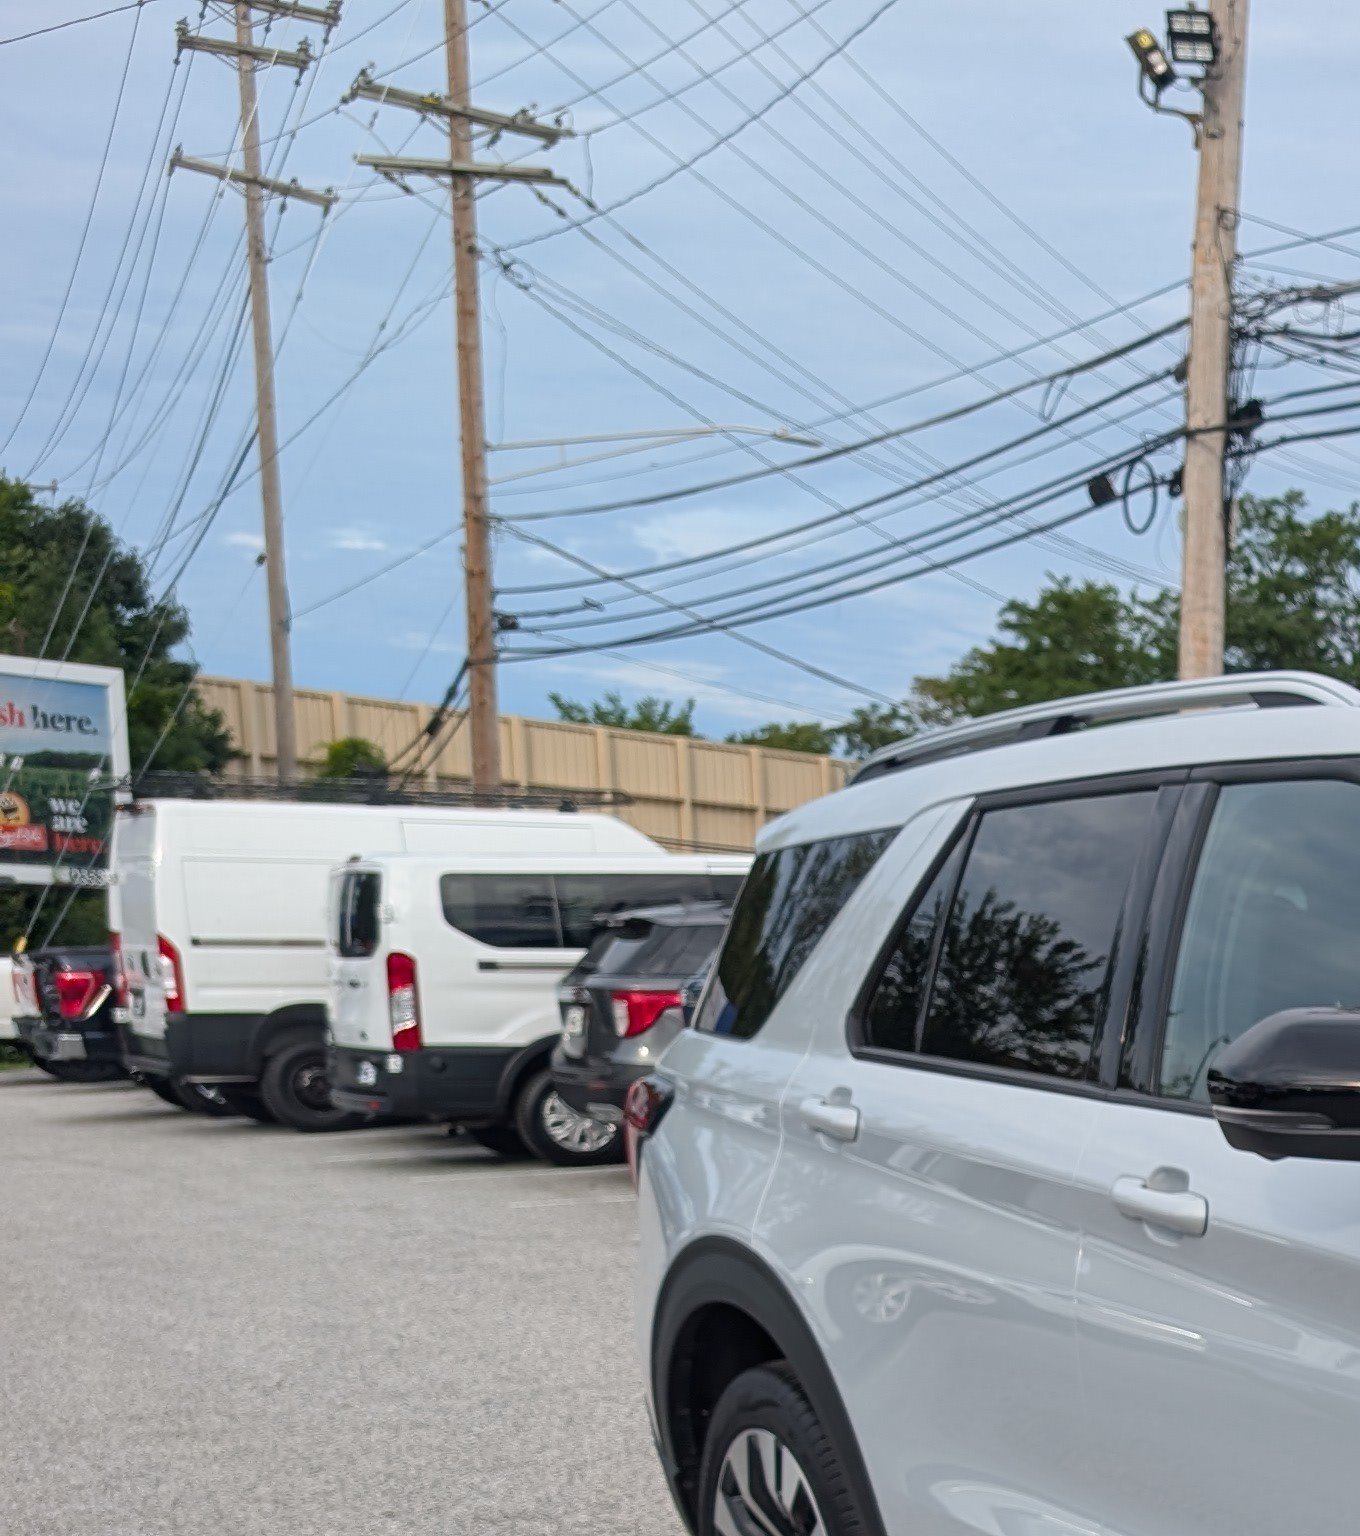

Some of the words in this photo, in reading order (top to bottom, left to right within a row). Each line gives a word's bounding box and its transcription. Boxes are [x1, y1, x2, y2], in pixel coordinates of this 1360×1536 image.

[31, 703, 98, 736] here.
[49, 798, 82, 815] we
[51, 815, 88, 833] are
